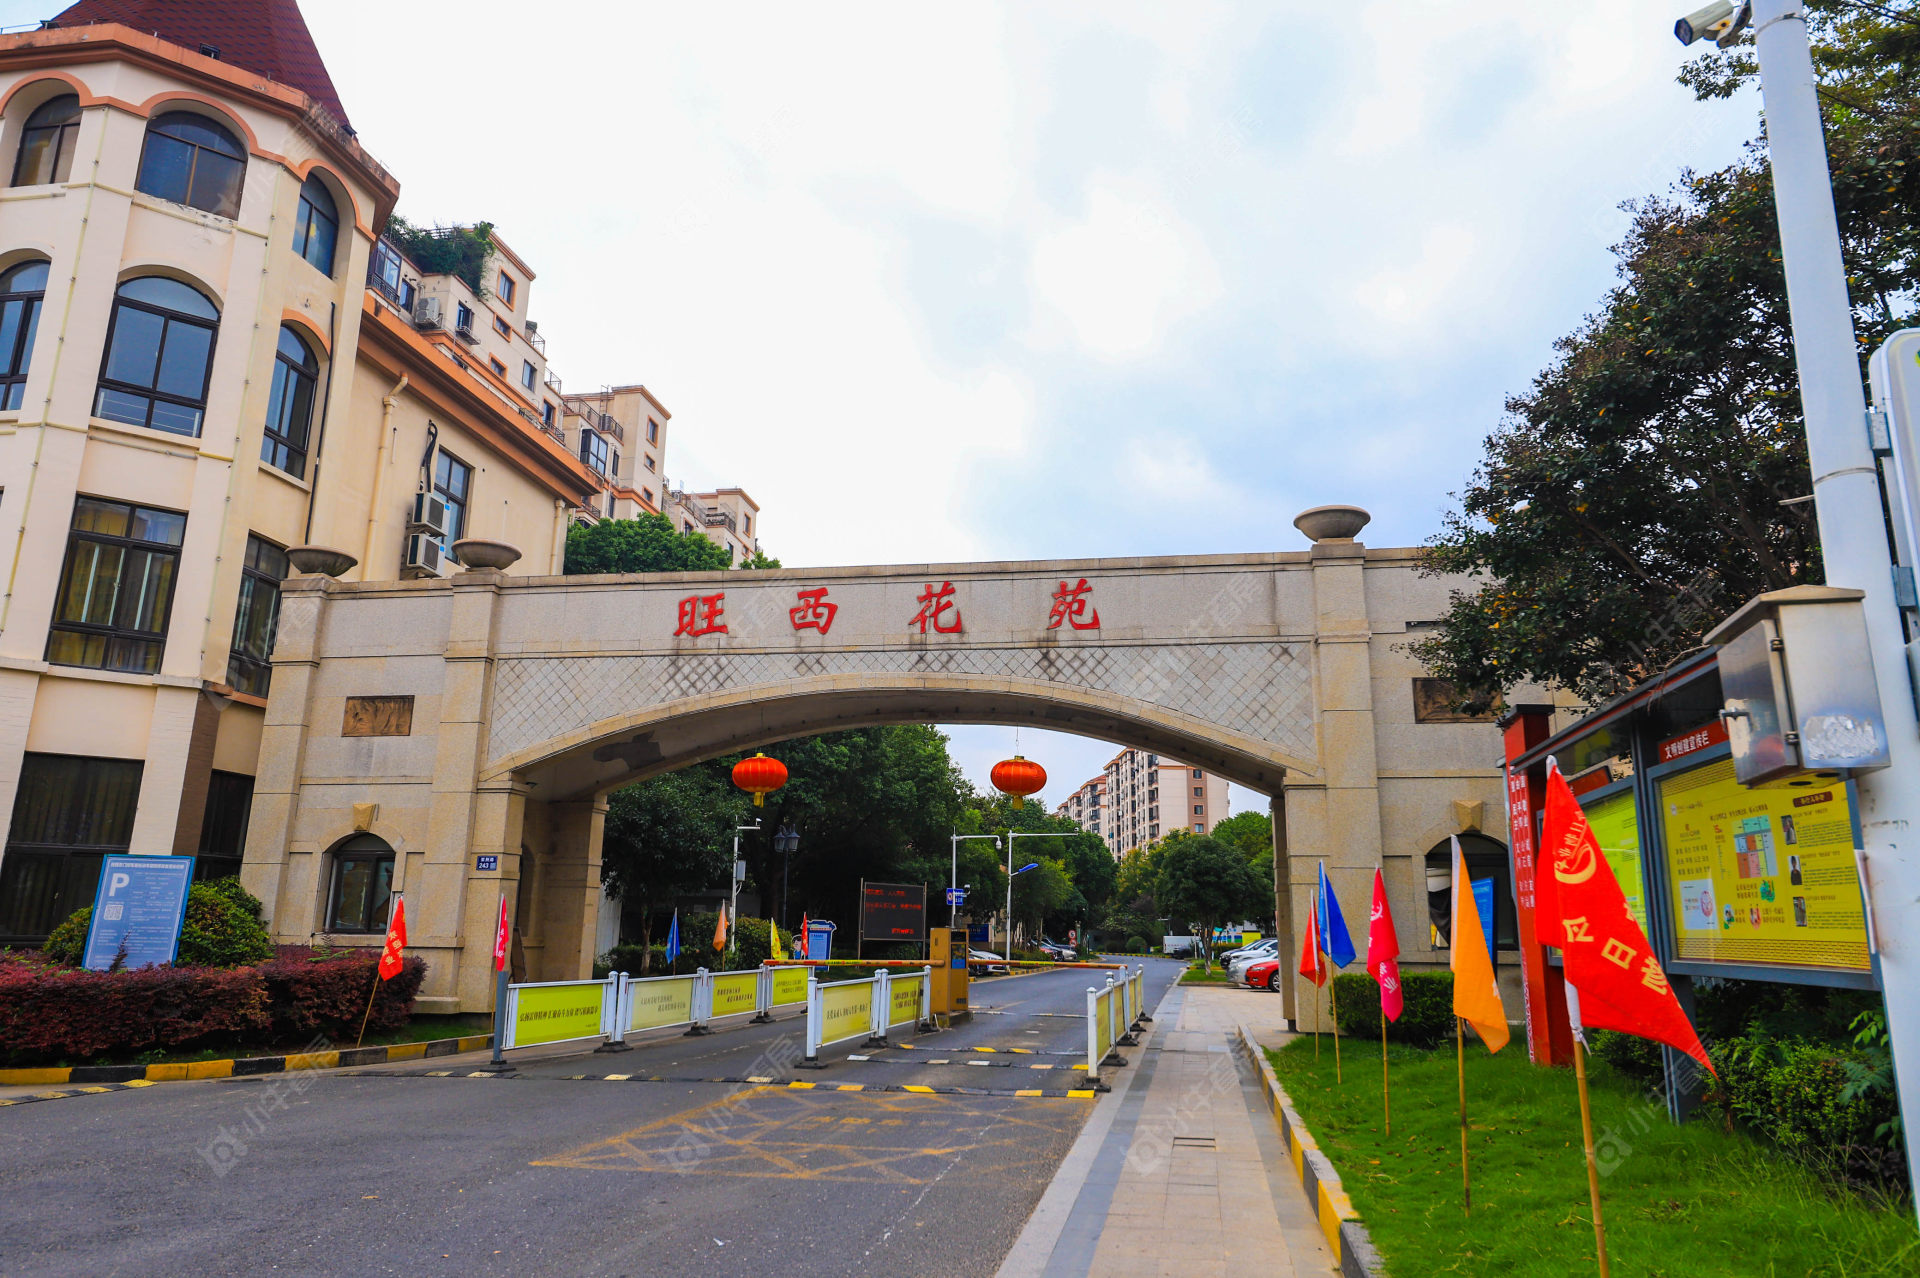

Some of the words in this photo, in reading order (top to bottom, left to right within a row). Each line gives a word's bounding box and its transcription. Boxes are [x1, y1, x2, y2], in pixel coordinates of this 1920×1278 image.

[674, 578, 1100, 638] 旺西花苑
[1664, 730, 1709, 759] 文明创建宣传栏
[108, 873, 130, 897] P
